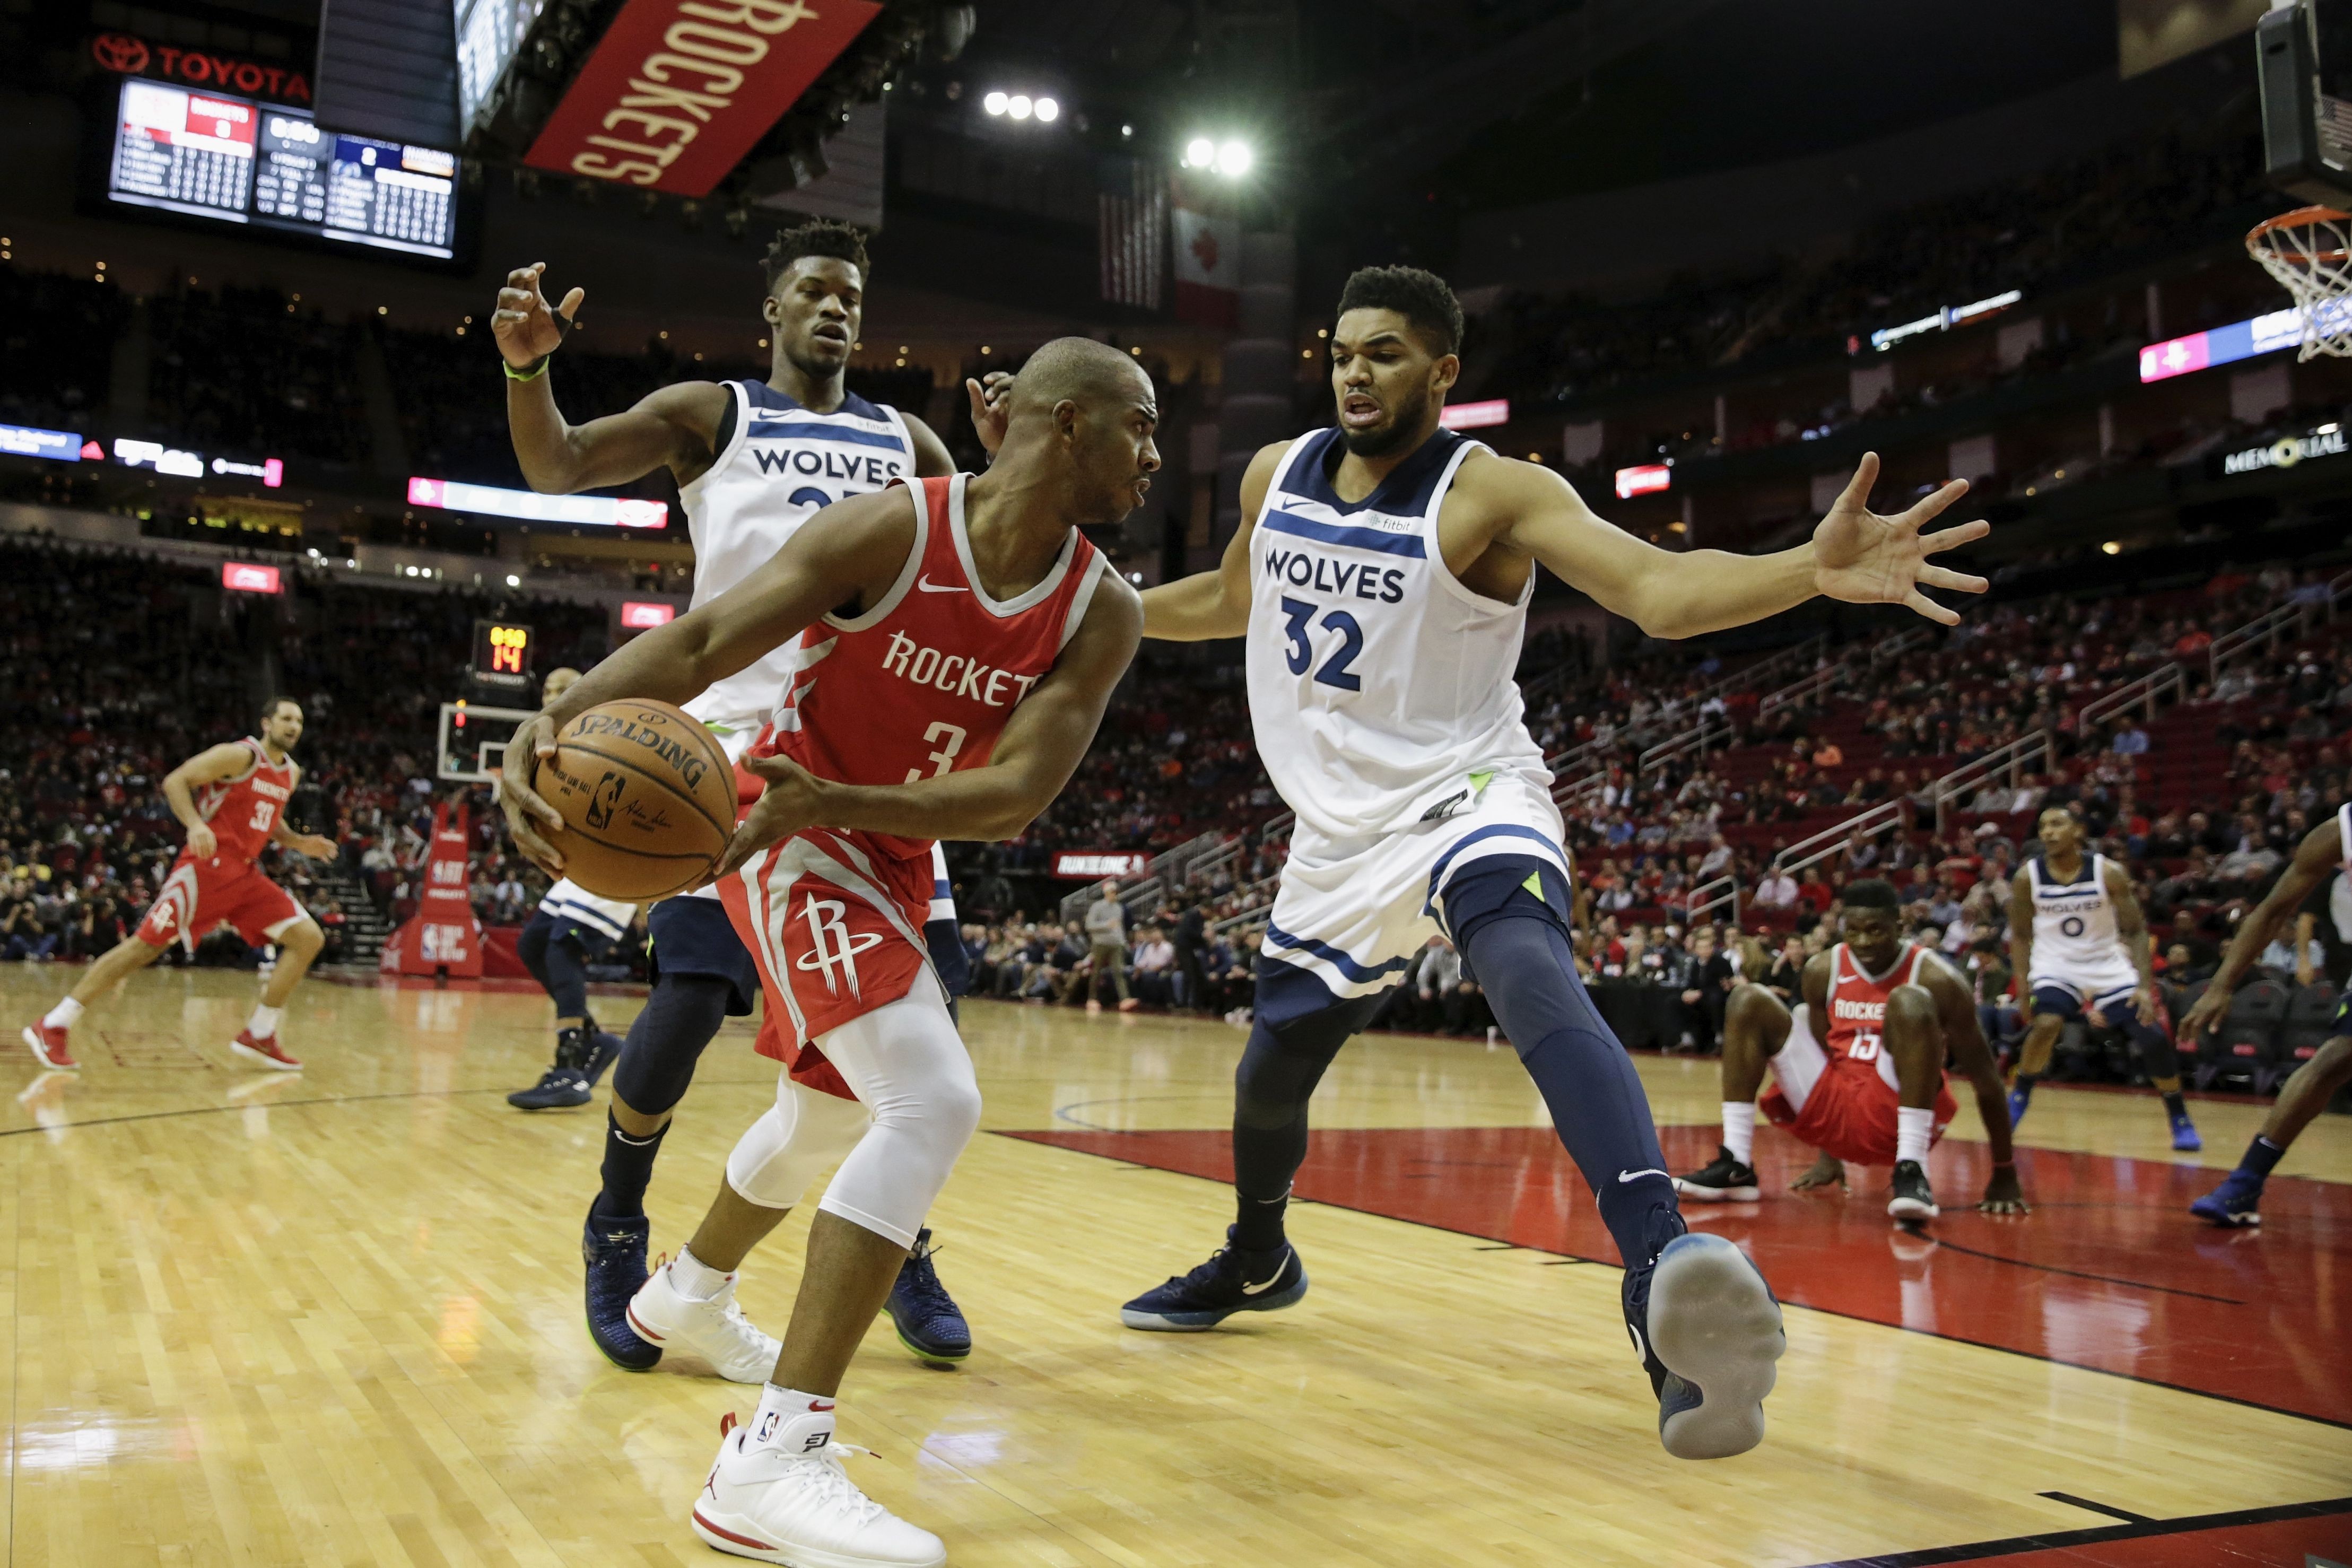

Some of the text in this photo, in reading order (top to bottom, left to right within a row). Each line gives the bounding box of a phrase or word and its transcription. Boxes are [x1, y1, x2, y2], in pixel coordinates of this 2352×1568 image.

[158, 46, 311, 101] TOYOTA
[572, 0, 820, 186] ROCKETS
[753, 449, 901, 486] WOLVES
[2225, 430, 2349, 472] MEMORIAL
[1383, 518, 1410, 531] fitbit
[1266, 545, 1405, 604] WOLVES
[493, 646, 522, 673] 14
[882, 629, 1044, 708] ROCKET
[1282, 595, 1363, 692] 32
[571, 714, 708, 789] SPALDING
[903, 721, 967, 785] 3
[2061, 917, 2084, 937] 0
[1835, 997, 1886, 1021] ROCKE
